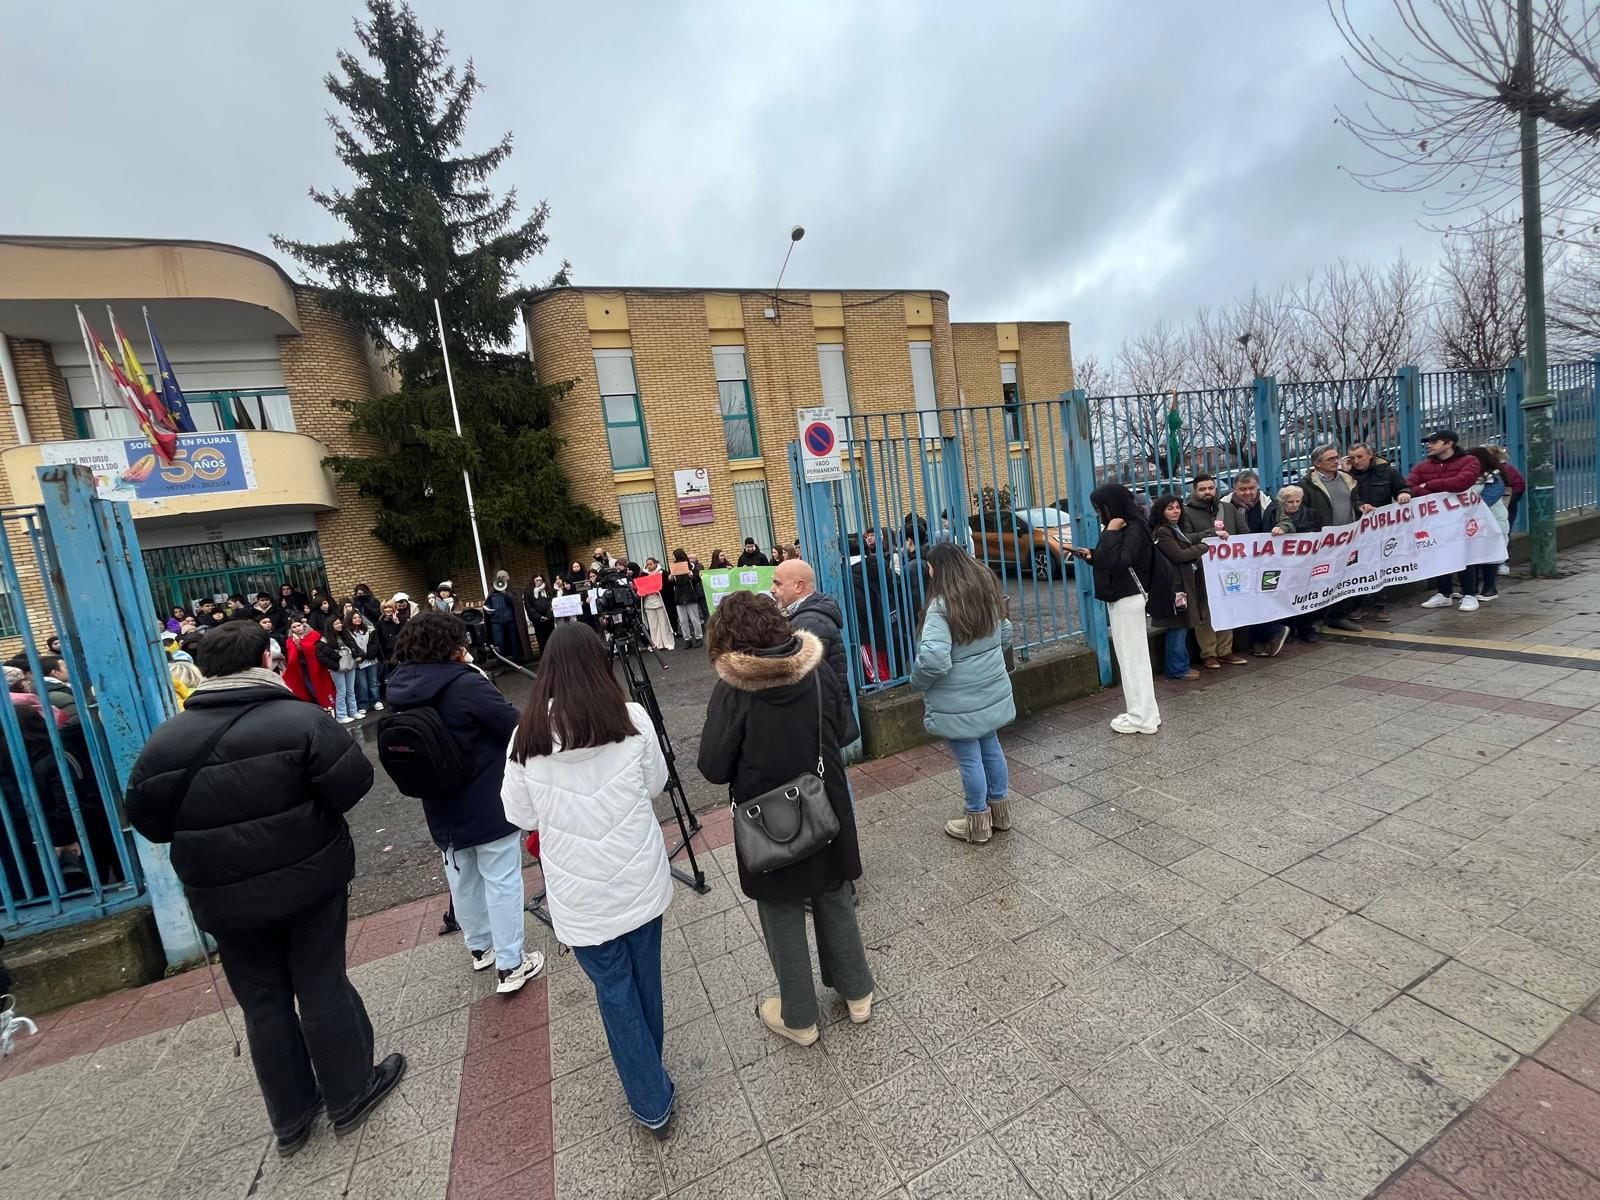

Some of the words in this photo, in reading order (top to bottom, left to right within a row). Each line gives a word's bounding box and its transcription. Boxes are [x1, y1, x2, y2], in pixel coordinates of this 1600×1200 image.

[182, 438, 195, 446] EN
[196, 436, 232, 446] PLURAL
[159, 447, 227, 483] 50
[194, 458, 226, 470] AÑOS
[806, 467, 840, 475] PERMANENTE
[1208, 543, 1247, 561] POR
[1253, 540, 1275, 558] LA
[1418, 500, 1440, 518] DE
[1333, 572, 1377, 592] ersonal
